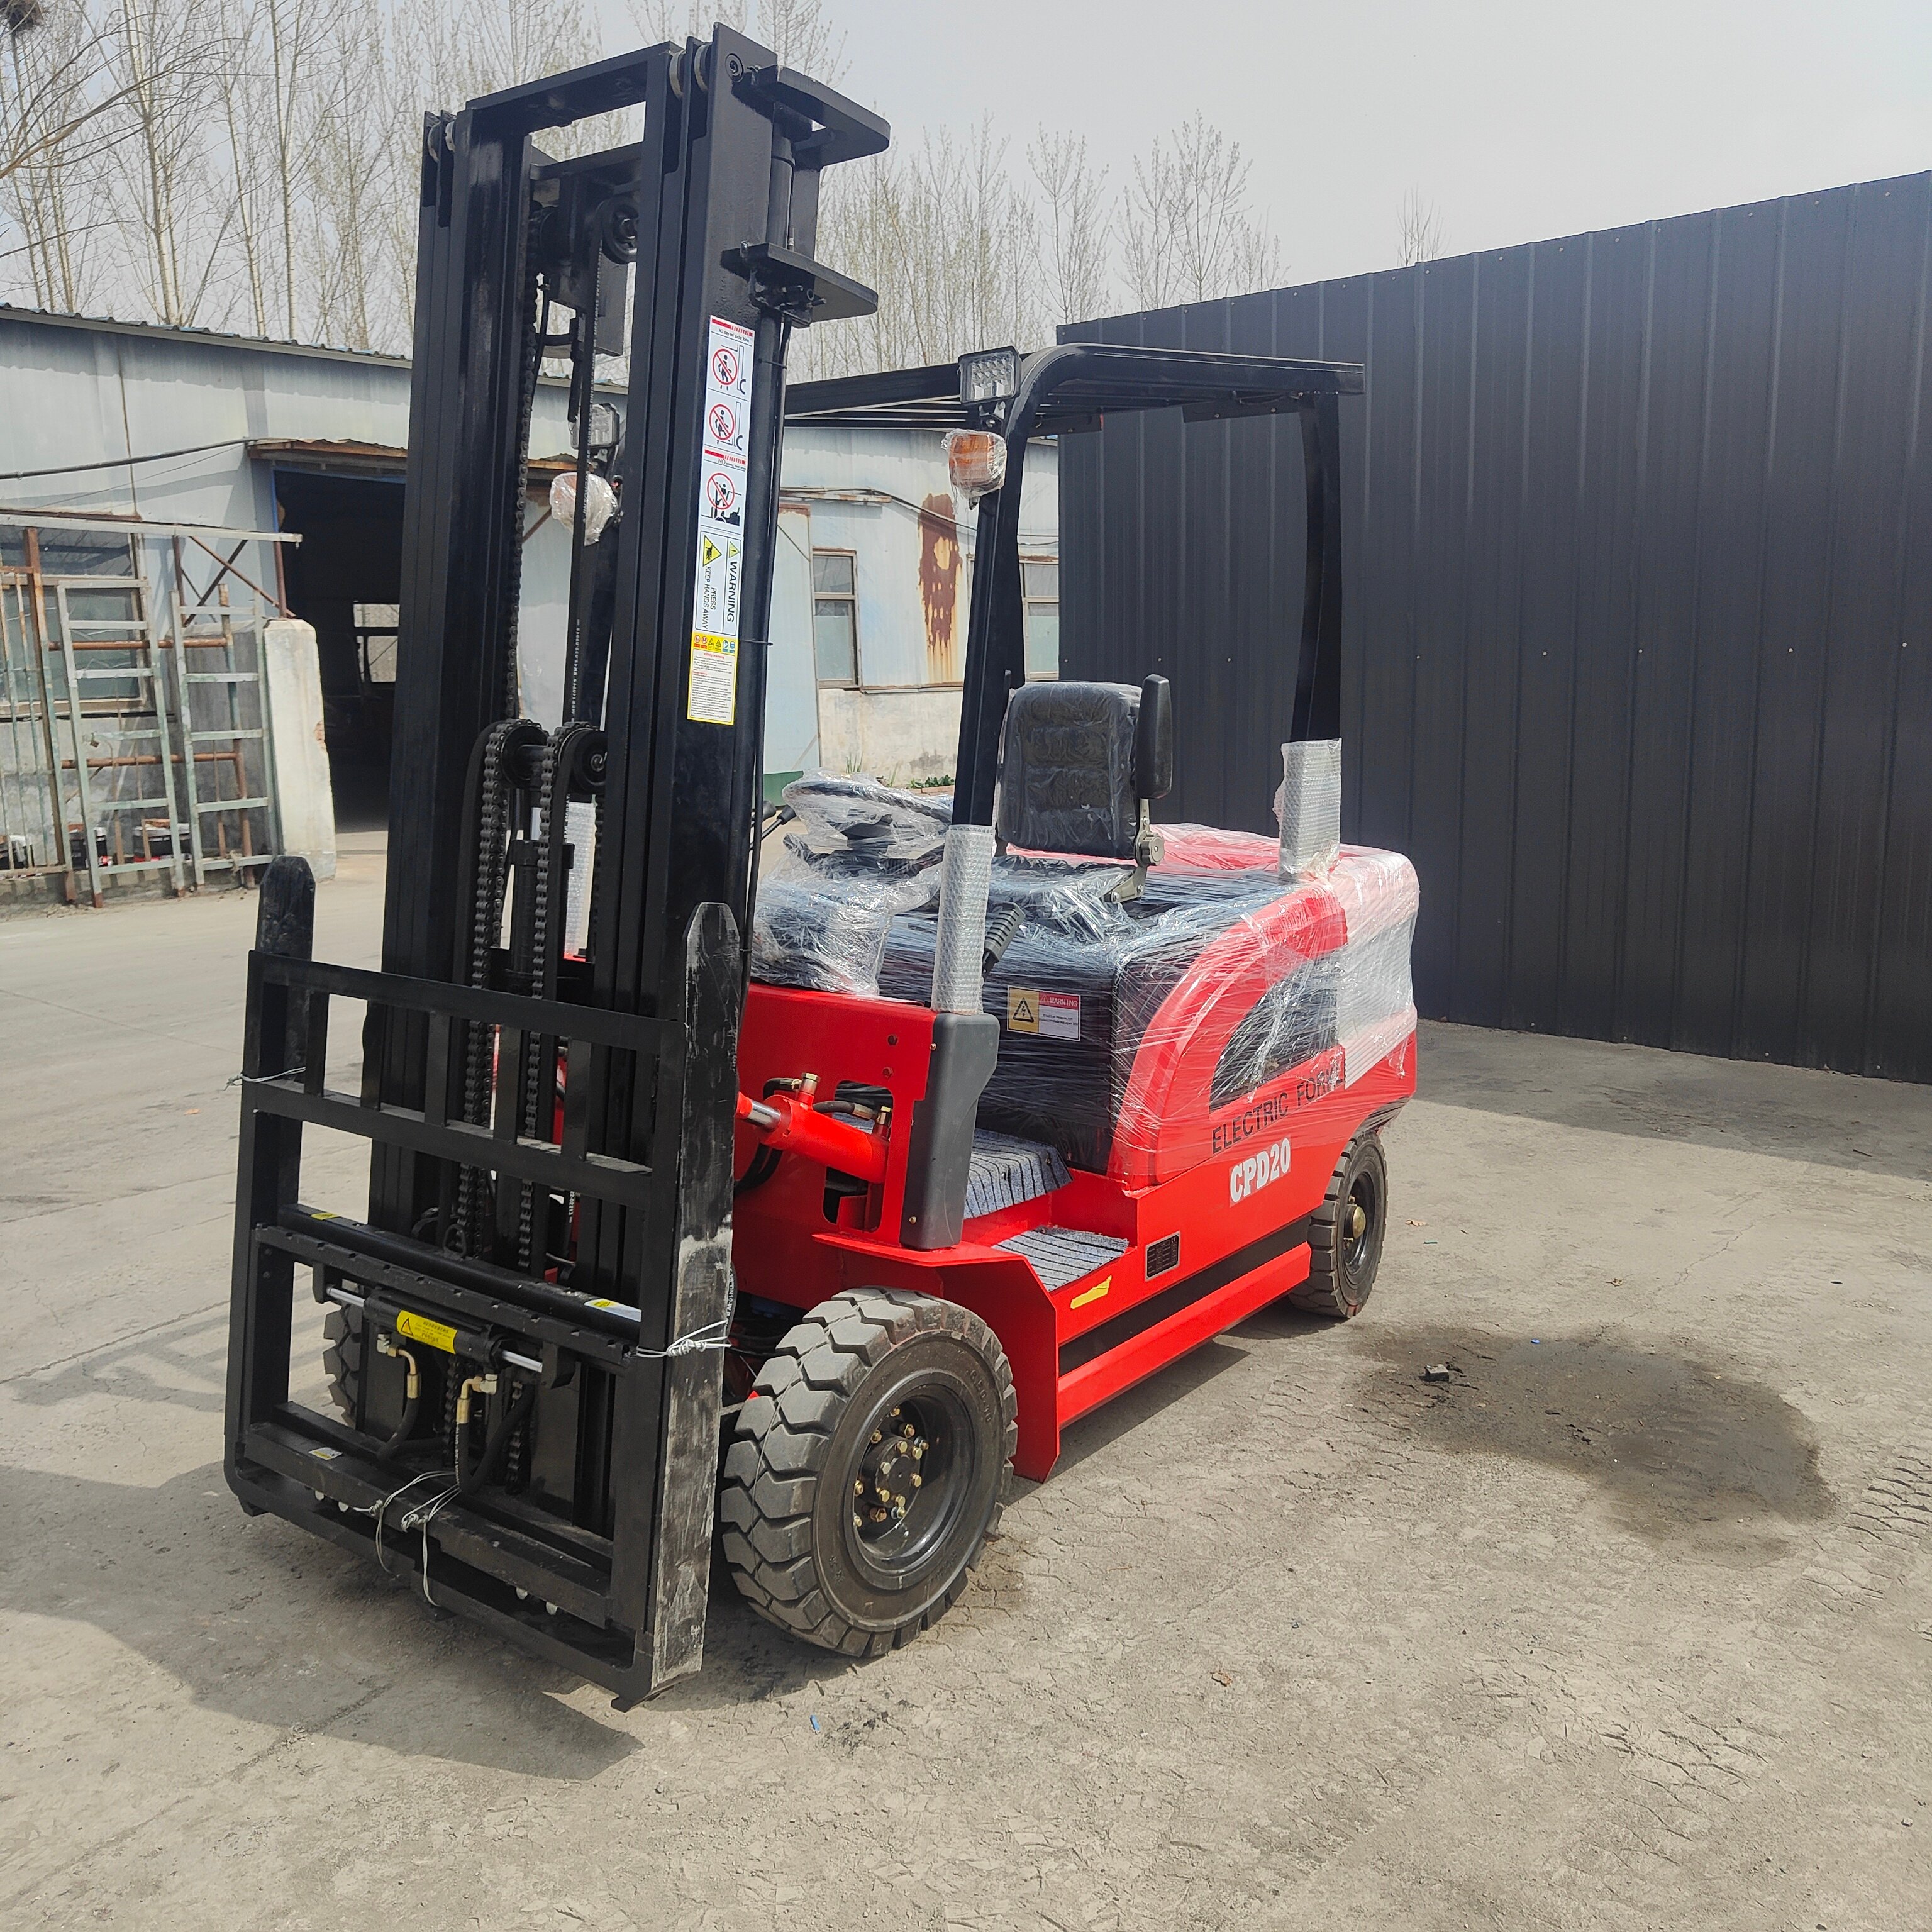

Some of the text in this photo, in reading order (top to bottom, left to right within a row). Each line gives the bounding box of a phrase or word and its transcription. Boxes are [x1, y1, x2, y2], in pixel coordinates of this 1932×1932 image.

[726, 561, 738, 622] WARNING
[1049, 997, 1078, 1007] WARNING
[1213, 1092, 1288, 1154] ELECTRIC
[1230, 1138, 1291, 1202] CPD20
